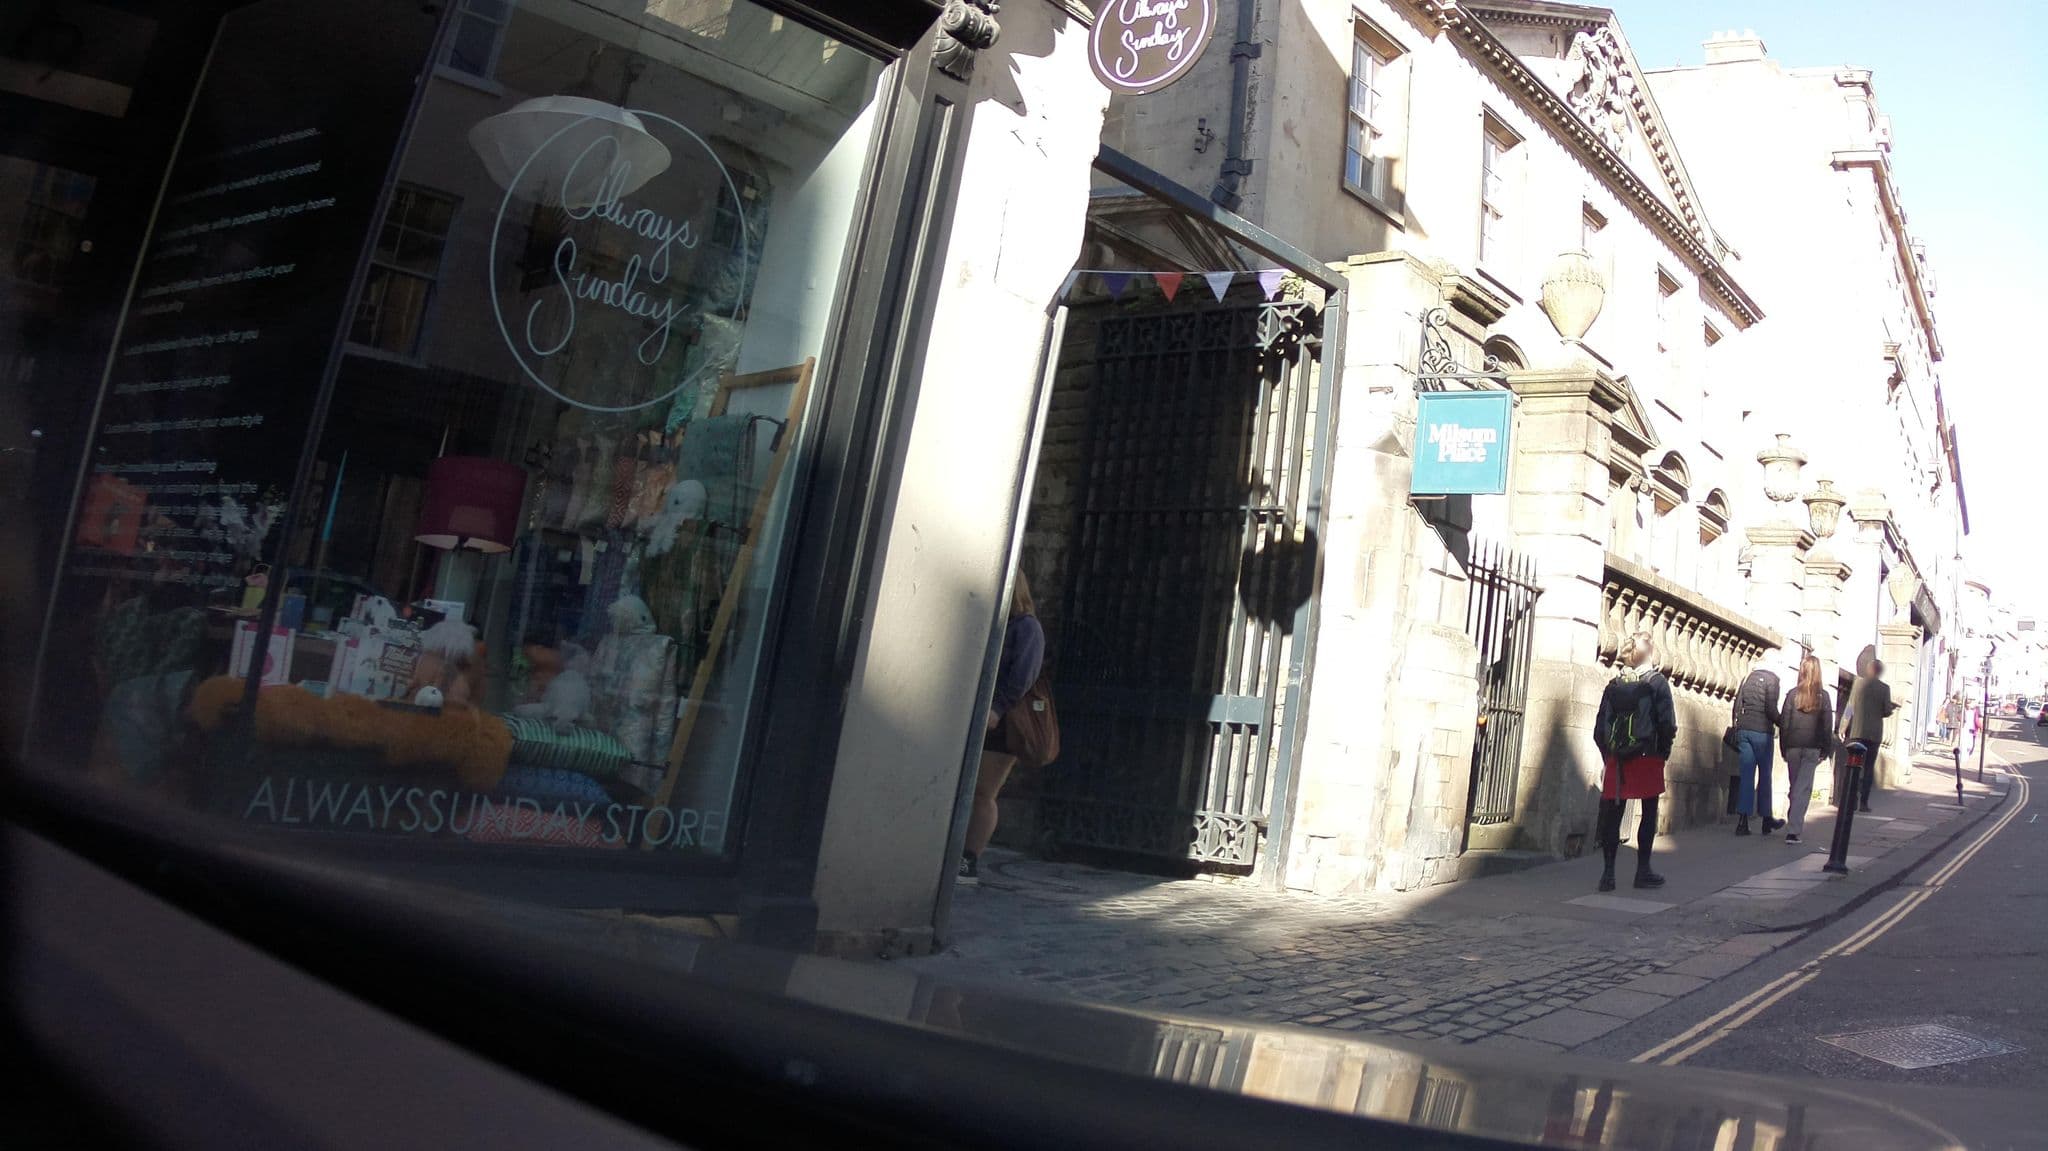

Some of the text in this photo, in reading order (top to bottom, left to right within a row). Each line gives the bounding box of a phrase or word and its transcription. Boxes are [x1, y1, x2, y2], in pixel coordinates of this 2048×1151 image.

[1115, 20, 1191, 78] Sunday
[561, 135, 698, 283] Always
[526, 236, 690, 365] Sunday
[1428, 423, 1497, 444] Milsom
[1438, 443, 1488, 463] Place
